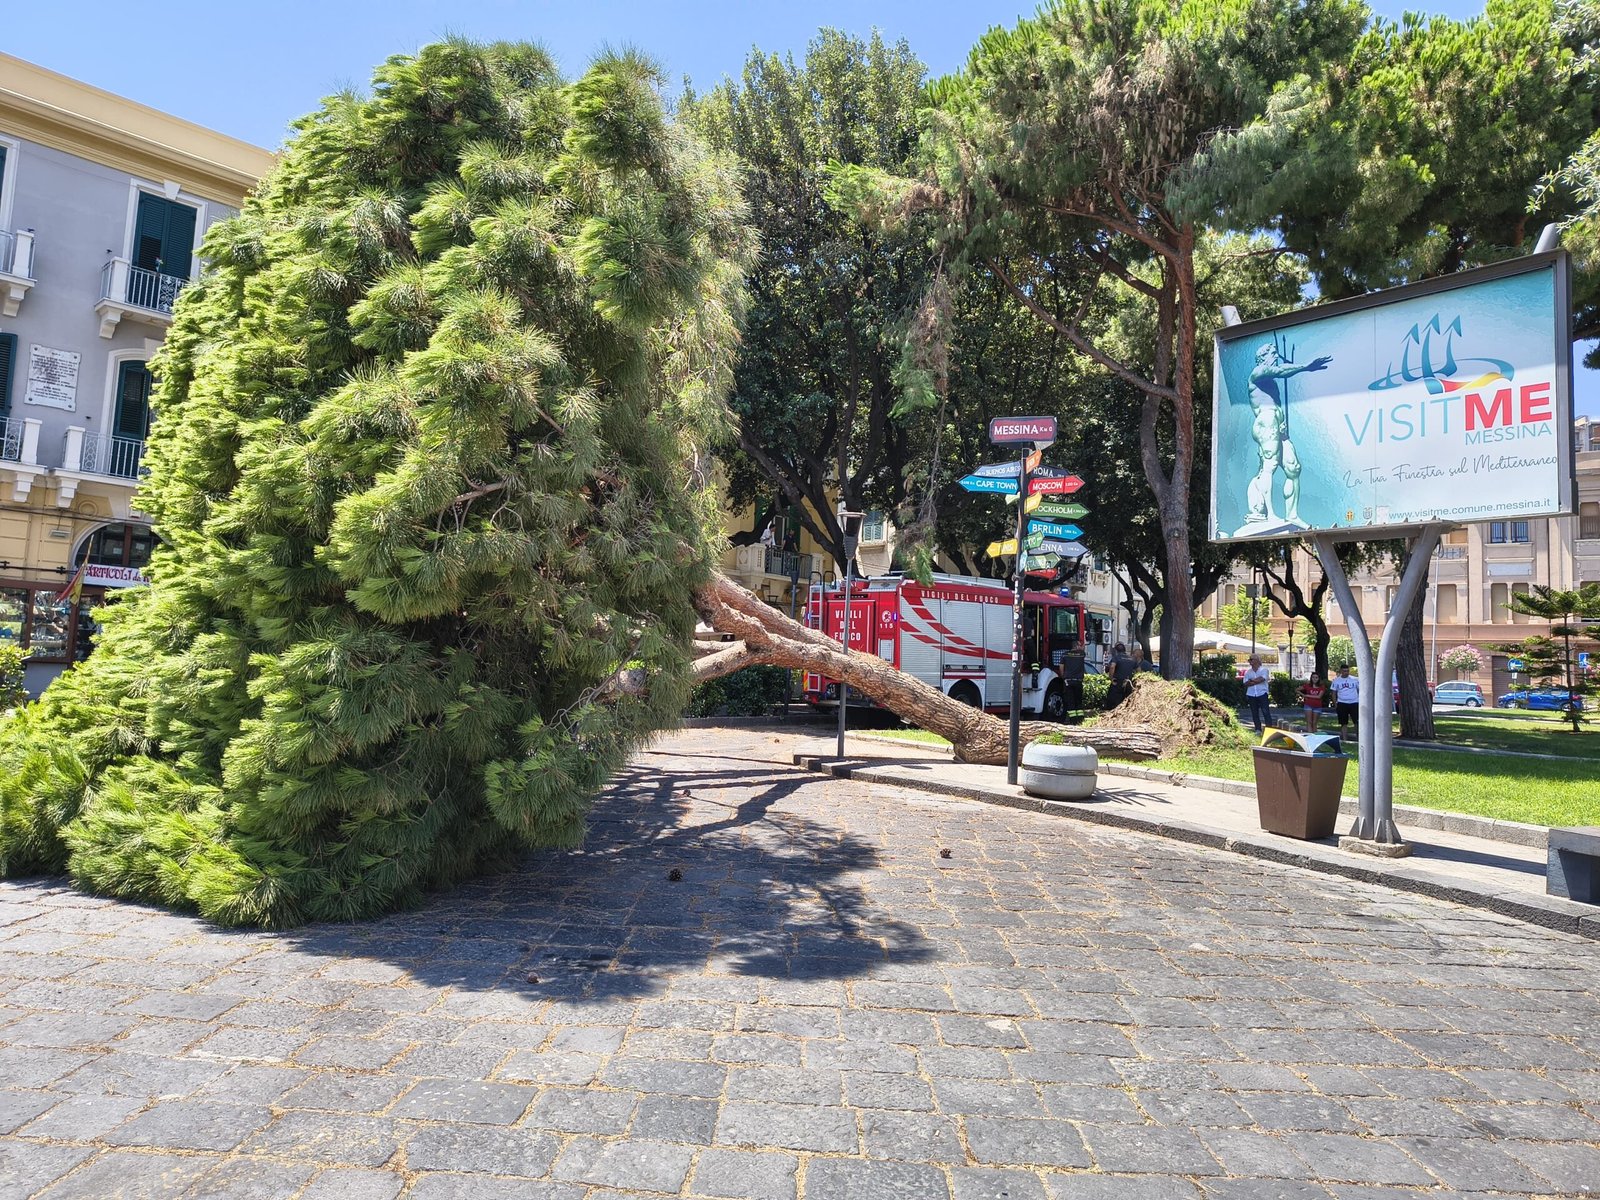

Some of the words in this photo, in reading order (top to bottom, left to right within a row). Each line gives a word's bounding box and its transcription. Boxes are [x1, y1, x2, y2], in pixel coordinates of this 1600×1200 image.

[994, 424, 1039, 436] MESSINA
[1464, 422, 1553, 446] MESSINA
[985, 467, 1006, 476] BUENOS
[1033, 467, 1054, 477] ROMA
[1343, 470, 1363, 489] La
[1363, 467, 1387, 484] Tua
[1392, 463, 1445, 483] Finestra
[1448, 457, 1469, 477] sul
[1473, 454, 1558, 474] Mediterraneo
[976, 480, 995, 488] CAPE
[996, 482, 1017, 490] TOWN
[1032, 481, 1063, 490] MOSCOW
[1035, 505, 1073, 515] OCKHOLM
[1388, 498, 1551, 520] www.visitme.comune.messina.it
[1032, 523, 1062, 535] BERLIN
[1038, 543, 1063, 552] ENNA
[85, 564, 133, 580] ARTICOLI
[921, 590, 950, 599] VIGILI
[954, 593, 969, 601] DEL
[974, 595, 999, 603] FUOCO
[835, 610, 862, 618] VIILI
[839, 621, 856, 629] DL
[834, 632, 861, 640] FUCO
